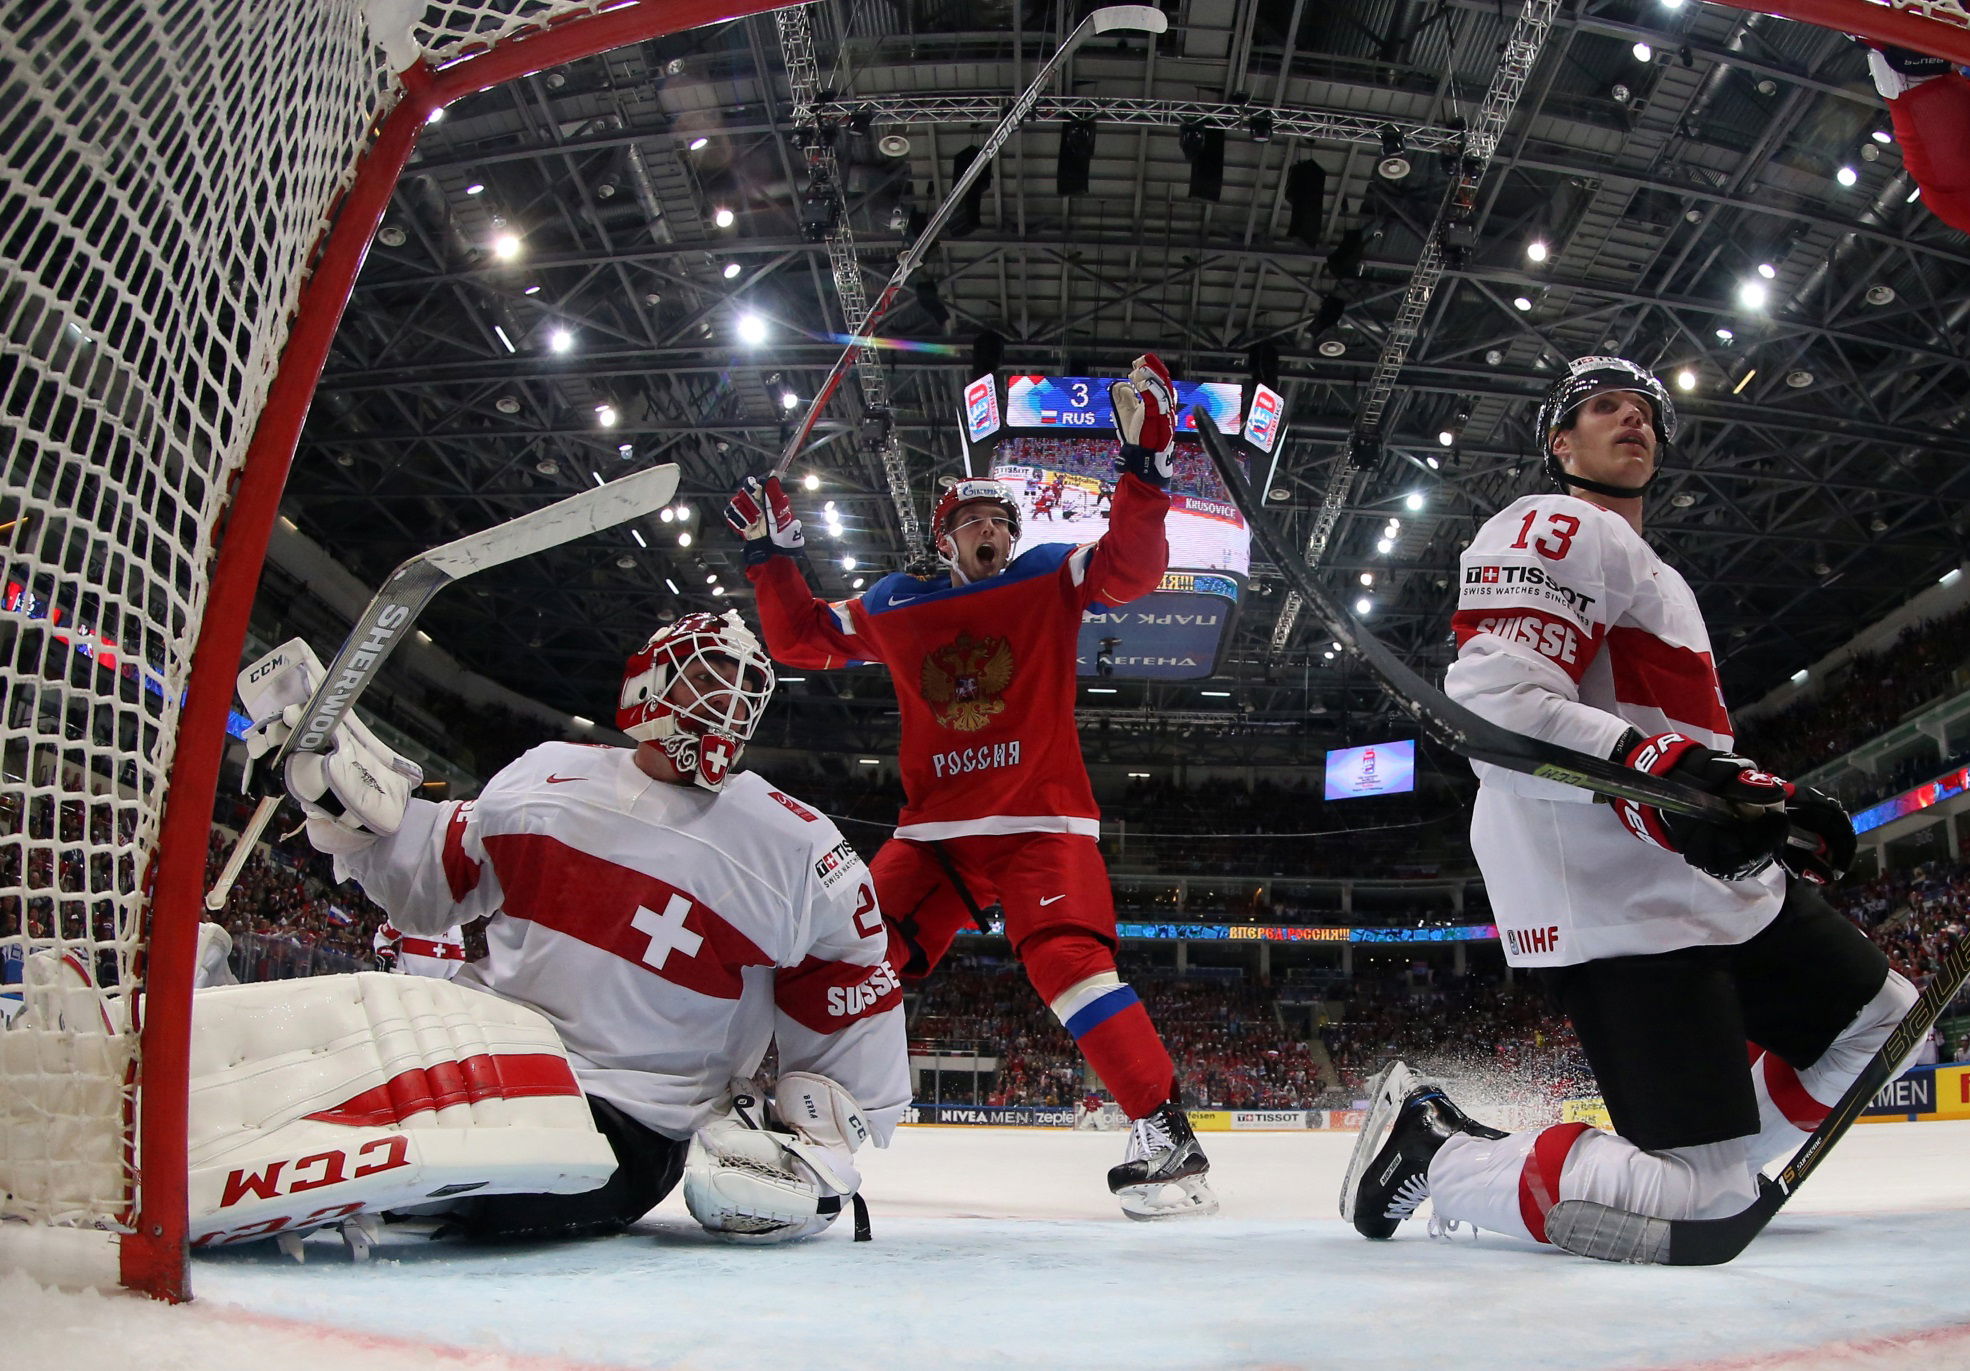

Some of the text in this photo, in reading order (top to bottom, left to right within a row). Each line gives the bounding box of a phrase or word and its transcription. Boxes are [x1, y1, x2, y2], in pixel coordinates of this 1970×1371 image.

[1071, 383, 1089, 407] 3
[1062, 412, 1095, 424] RUS
[1509, 510, 1581, 561] 13
[1464, 587, 1491, 596] SWISS
[1496, 586, 1540, 596] WATCHES
[1502, 566, 1596, 612] TISSOT
[1138, 614, 1217, 625] ПАРК
[250, 655, 283, 683] CCM
[933, 741, 1021, 778] РОССИЯ
[831, 839, 854, 860] TIS
[824, 854, 861, 888] SWISS WATCH
[852, 882, 885, 939] 2
[1517, 926, 1559, 954] IIHF
[827, 960, 901, 1017] SUISSE
[1881, 937, 1970, 1073] BAUE
[803, 1094, 819, 1120] BERRA
[1878, 1079, 1928, 1107] MEN
[848, 1114, 867, 1141] CC
[941, 1110, 1029, 1124] NIVEA MEN
[1187, 1112, 1216, 1120] feisen
[1255, 1113, 1299, 1122] TISSOT
[219, 1135, 412, 1207] CCM
